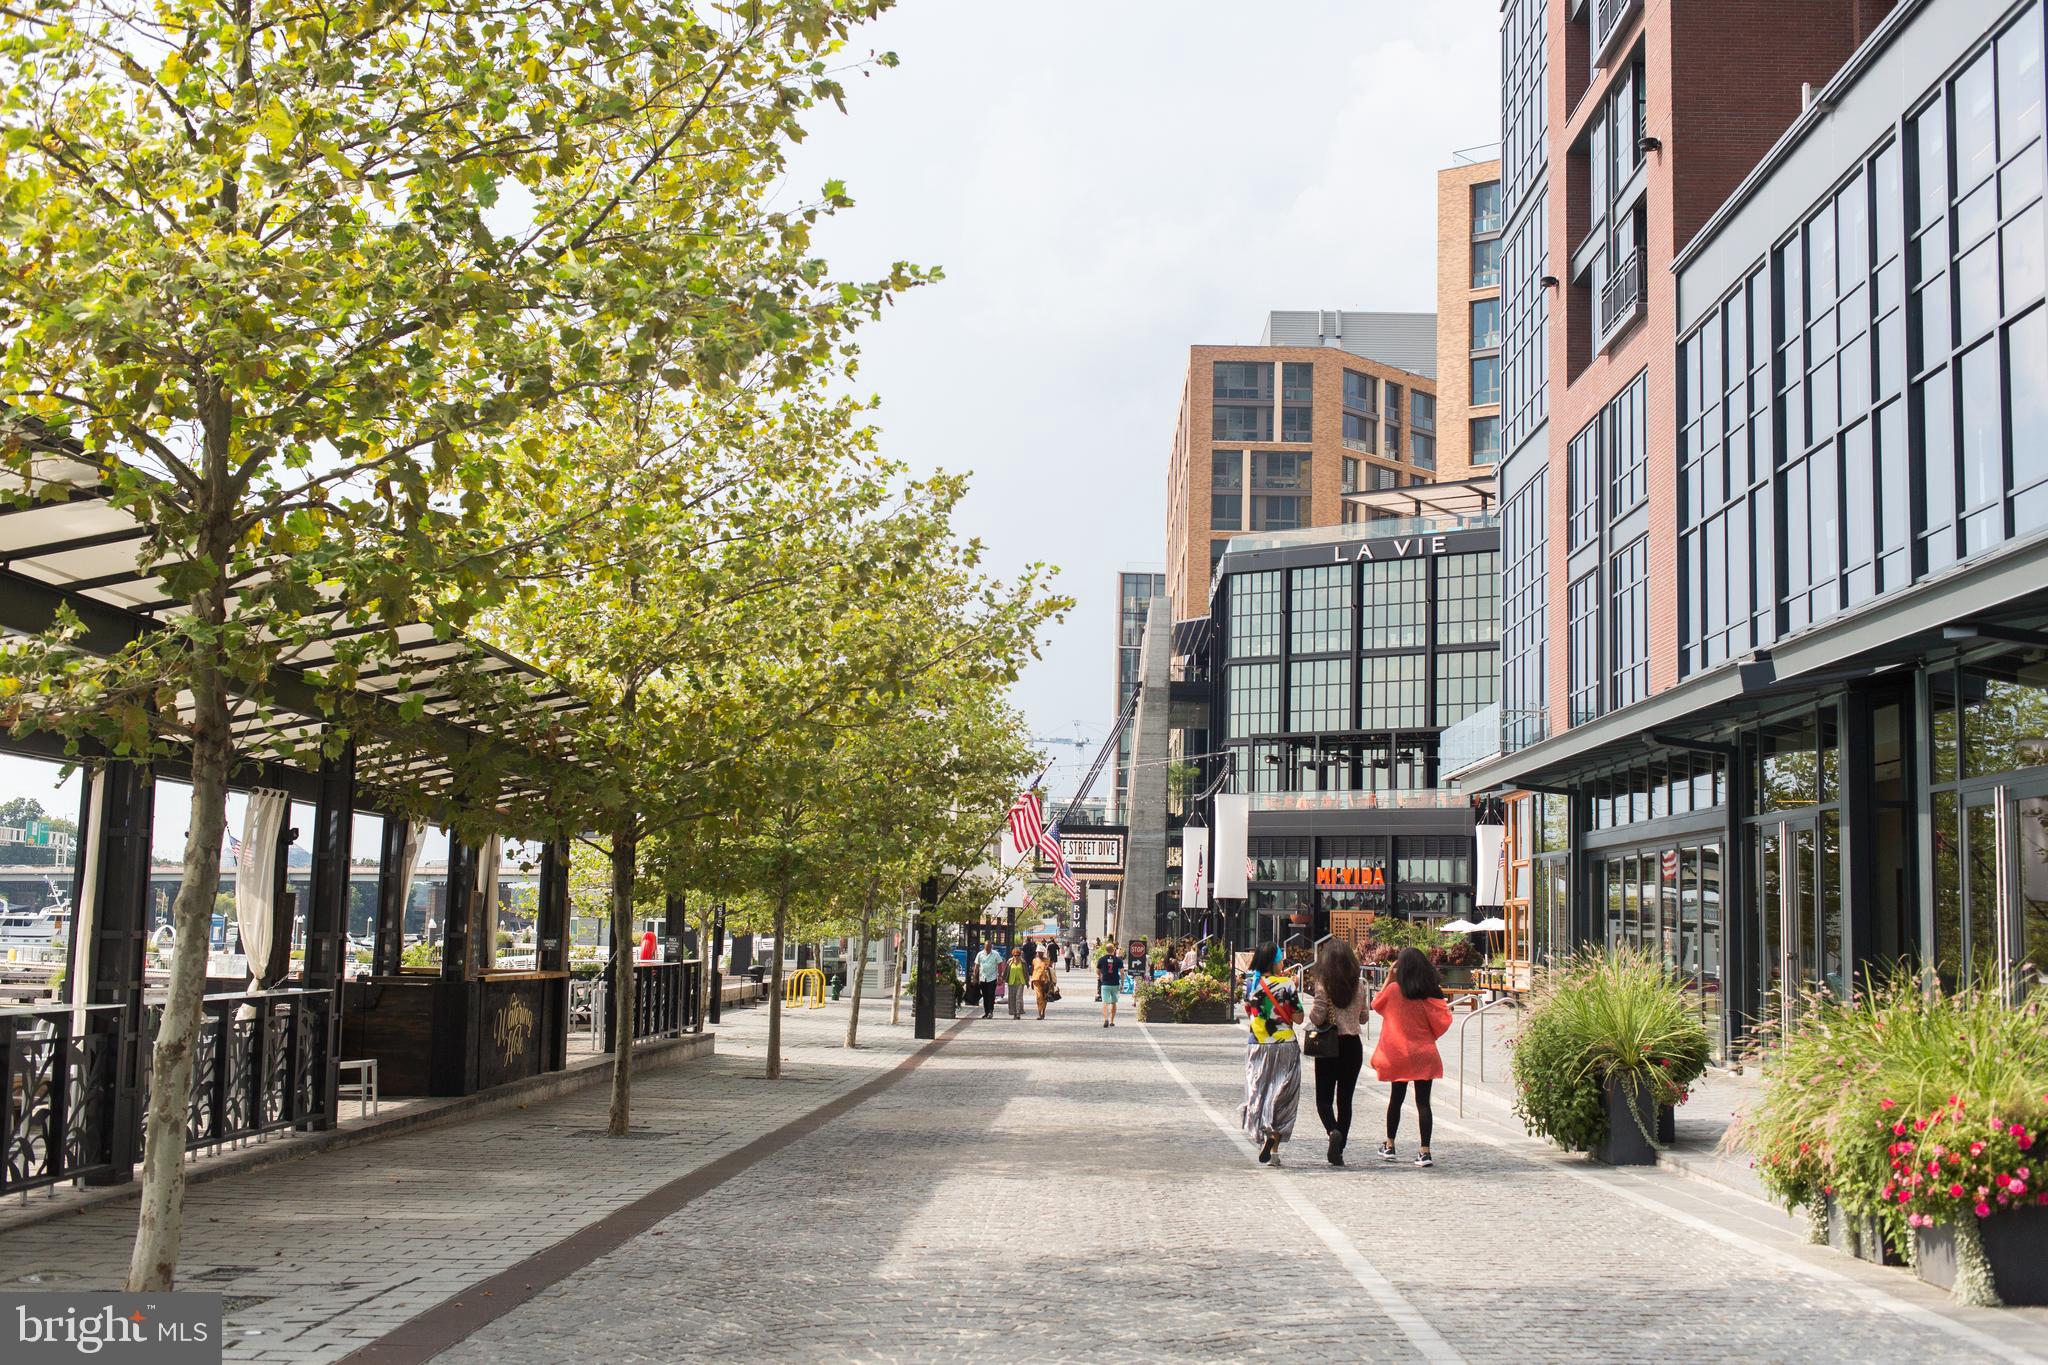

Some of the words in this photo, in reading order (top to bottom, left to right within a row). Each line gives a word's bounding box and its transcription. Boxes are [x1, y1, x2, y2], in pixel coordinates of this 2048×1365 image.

[1335, 544, 1373, 561] LA
[1394, 536, 1446, 556] VIE
[1069, 841, 1096, 855] STREET
[1099, 842, 1116, 856] DIVE
[1316, 867, 1336, 886] MI
[1341, 866, 1385, 885] VIDA
[1073, 904, 1081, 928] RUM
